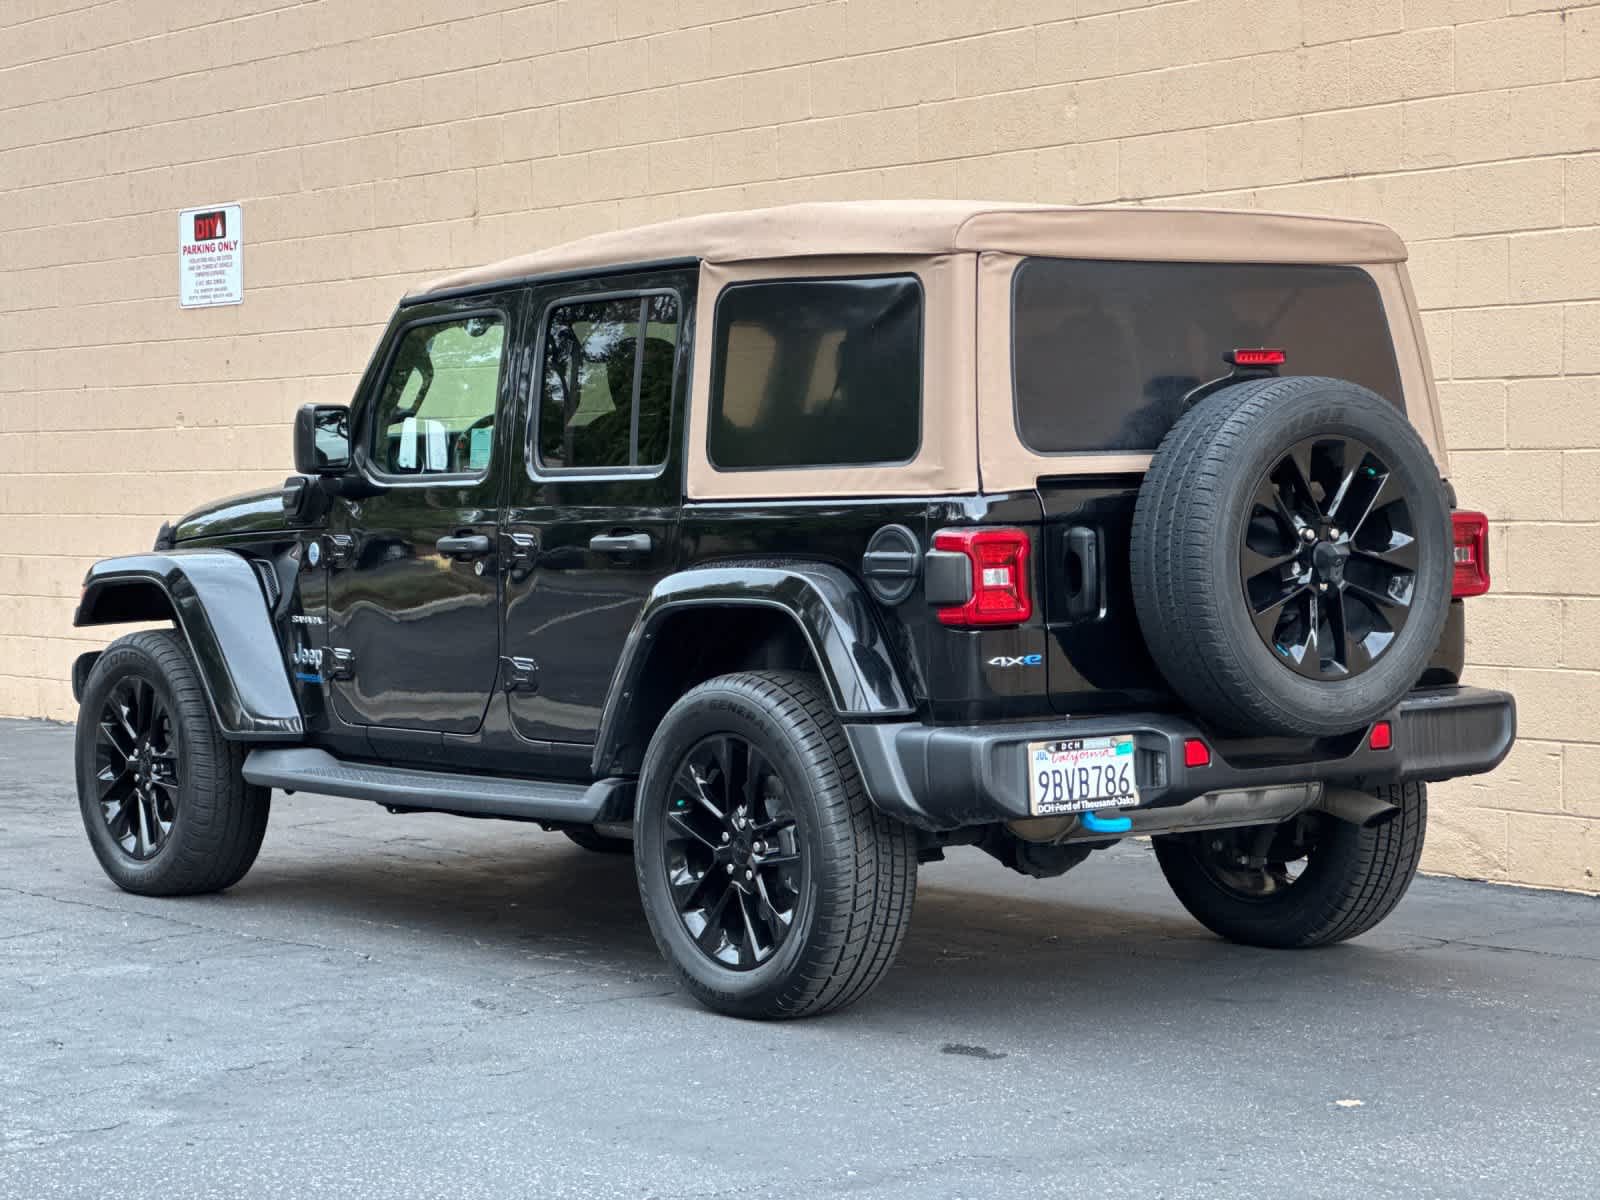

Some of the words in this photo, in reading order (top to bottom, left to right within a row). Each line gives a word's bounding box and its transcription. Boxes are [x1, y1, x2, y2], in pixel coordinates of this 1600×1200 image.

[182, 242, 216, 256] PARKING
[218, 240, 238, 252] ONLY
[293, 642, 323, 670] Jeep
[1061, 741, 1081, 750] DCH
[1036, 751, 1048, 761] JUL
[1038, 762, 1130, 804] 9BVB786
[1072, 801, 1081, 810] of
[1081, 797, 1116, 809] Thousand
